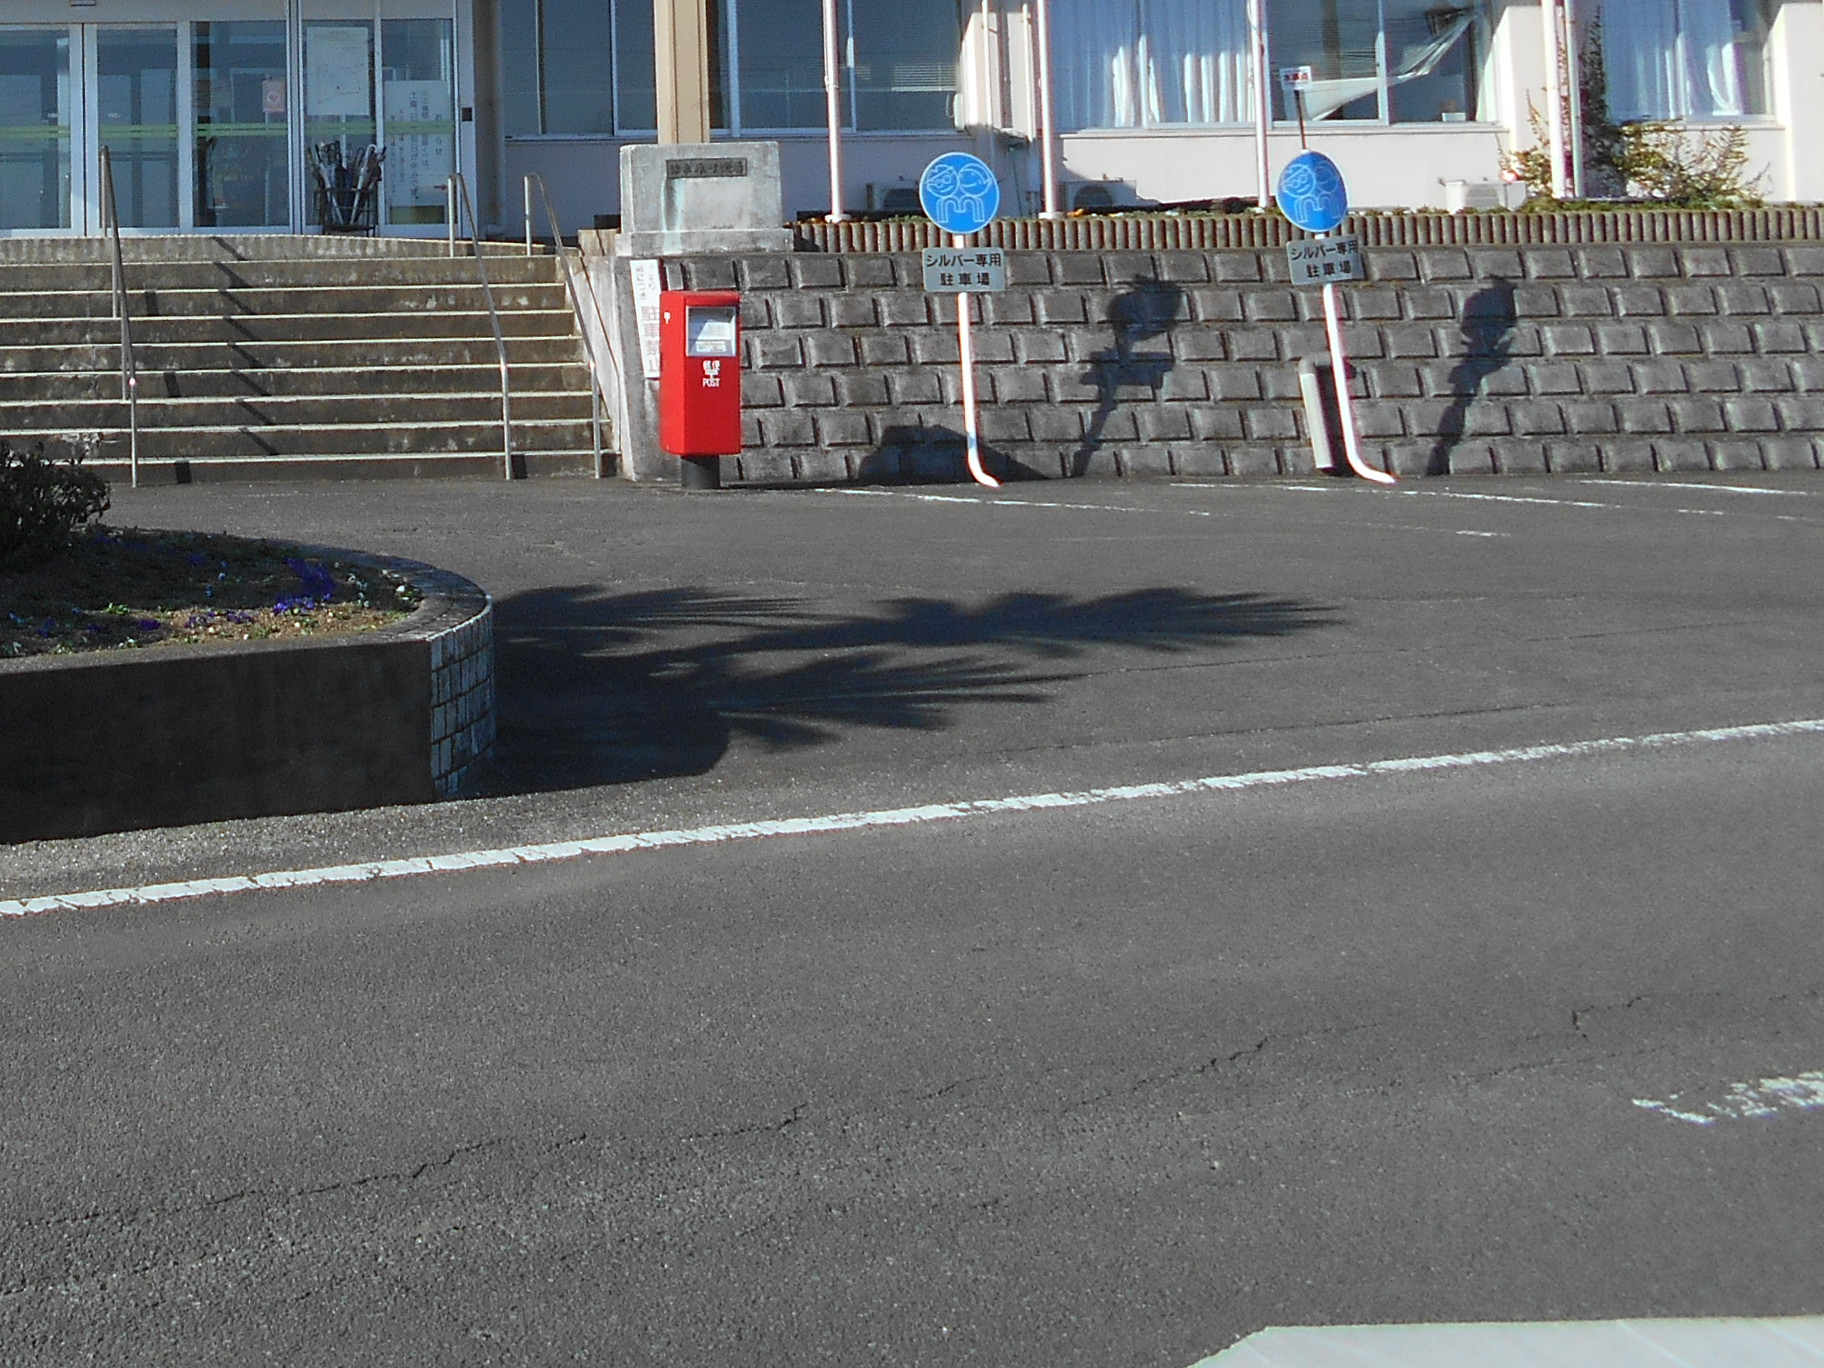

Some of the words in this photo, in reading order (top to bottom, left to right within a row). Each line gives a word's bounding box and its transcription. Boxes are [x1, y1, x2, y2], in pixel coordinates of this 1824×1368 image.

[1291, 240, 1358, 260] シルバー専用
[926, 253, 1001, 267] シルバー専用
[940, 272, 990, 286] 駐車場
[702, 377, 721, 388] POST
